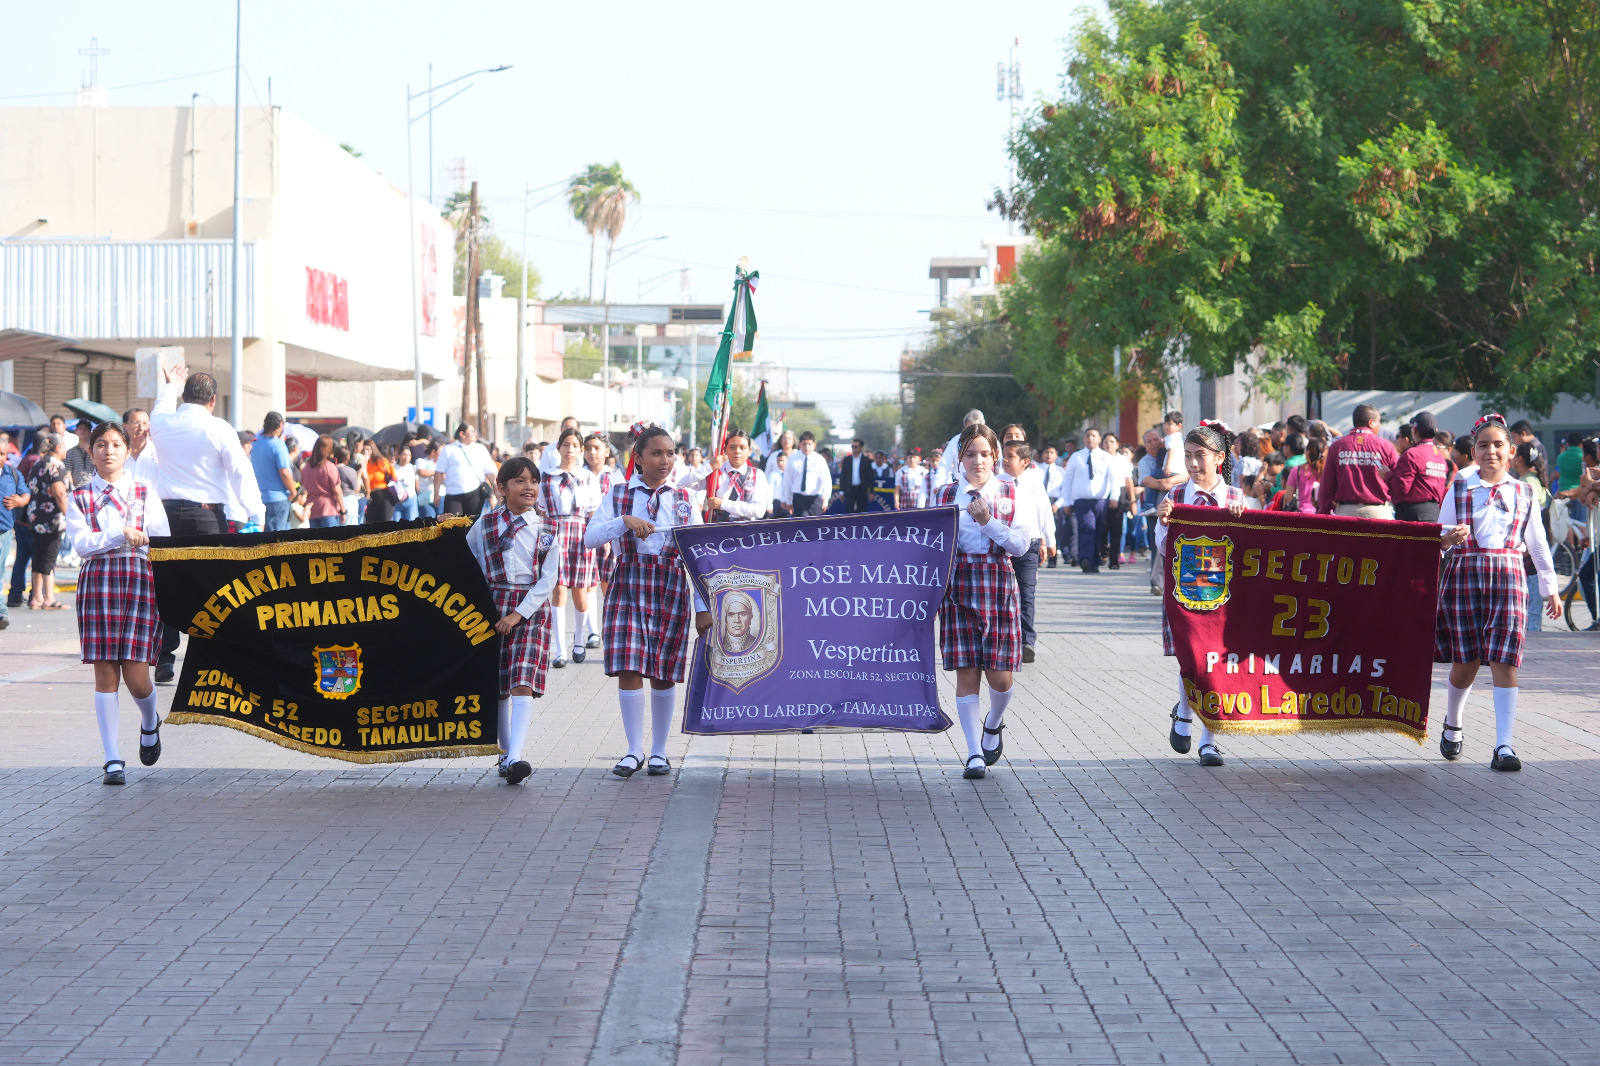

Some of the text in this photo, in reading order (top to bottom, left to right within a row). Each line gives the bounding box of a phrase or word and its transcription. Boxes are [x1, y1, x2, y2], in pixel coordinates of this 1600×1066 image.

[1338, 450, 1382, 460] GUARDIA
[688, 525, 945, 560] ESCUELA PRIMARIA
[789, 560, 942, 588] JOSÉ MARÍA
[1241, 548, 1378, 586] SECTOR
[256, 593, 400, 631] PRIMARIAS
[308, 556, 346, 585] DE
[360, 555, 496, 646] EDUCACION
[804, 596, 928, 621] MORELOS
[1271, 594, 1331, 639] 23
[807, 639, 921, 667] Vespertina
[1206, 651, 1387, 678] PRIMARIAS
[789, 670, 821, 679] ZONA
[823, 670, 868, 681] ESCOLAR
[870, 673, 883, 682] 52,
[926, 675, 936, 683] 23
[188, 690, 253, 715] NUEVO
[358, 720, 482, 746] TAMAULIPAS
[272, 699, 299, 721] 52
[357, 699, 439, 725] SECTOR
[454, 694, 481, 714] 23
[701, 701, 938, 720] NUEVO LAREDO, TAMAULIPAS
[1260, 684, 1364, 717] Laredo,
[1367, 684, 1426, 726] Tam.
